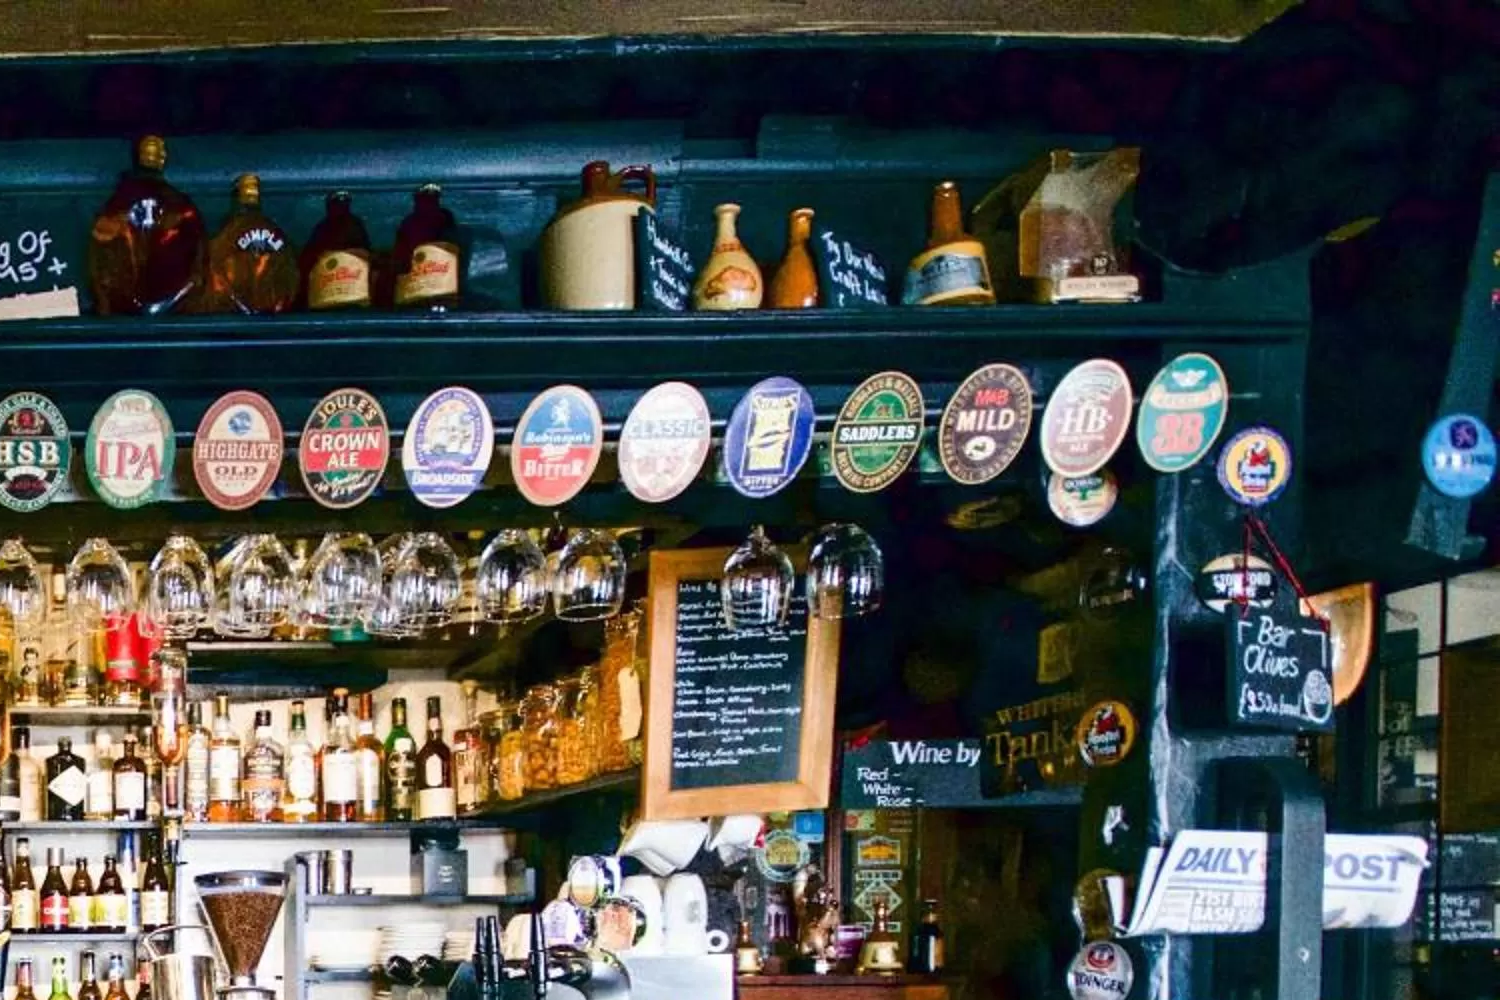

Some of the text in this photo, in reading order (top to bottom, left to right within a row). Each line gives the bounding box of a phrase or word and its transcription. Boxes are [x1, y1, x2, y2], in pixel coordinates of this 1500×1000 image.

[17, 230, 52, 263] Of
[236, 228, 285, 250] DIMPLE
[47, 257, 67, 275] +
[316, 398, 377, 424] JOULE'S
[956, 408, 1016, 432] MILD
[309, 431, 380, 451] CROWN
[839, 424, 917, 442] SADDLERS
[95, 440, 164, 481] IPA
[199, 441, 279, 460] HIGHGATE
[327, 451, 360, 468] ALE
[214, 465, 258, 476] OLD
[1257, 615, 1296, 648] Bar
[1243, 645, 1299, 677] Olives
[889, 741, 982, 766] Wine by
[862, 782, 902, 797] White
[1174, 846, 1260, 875] DAILY
